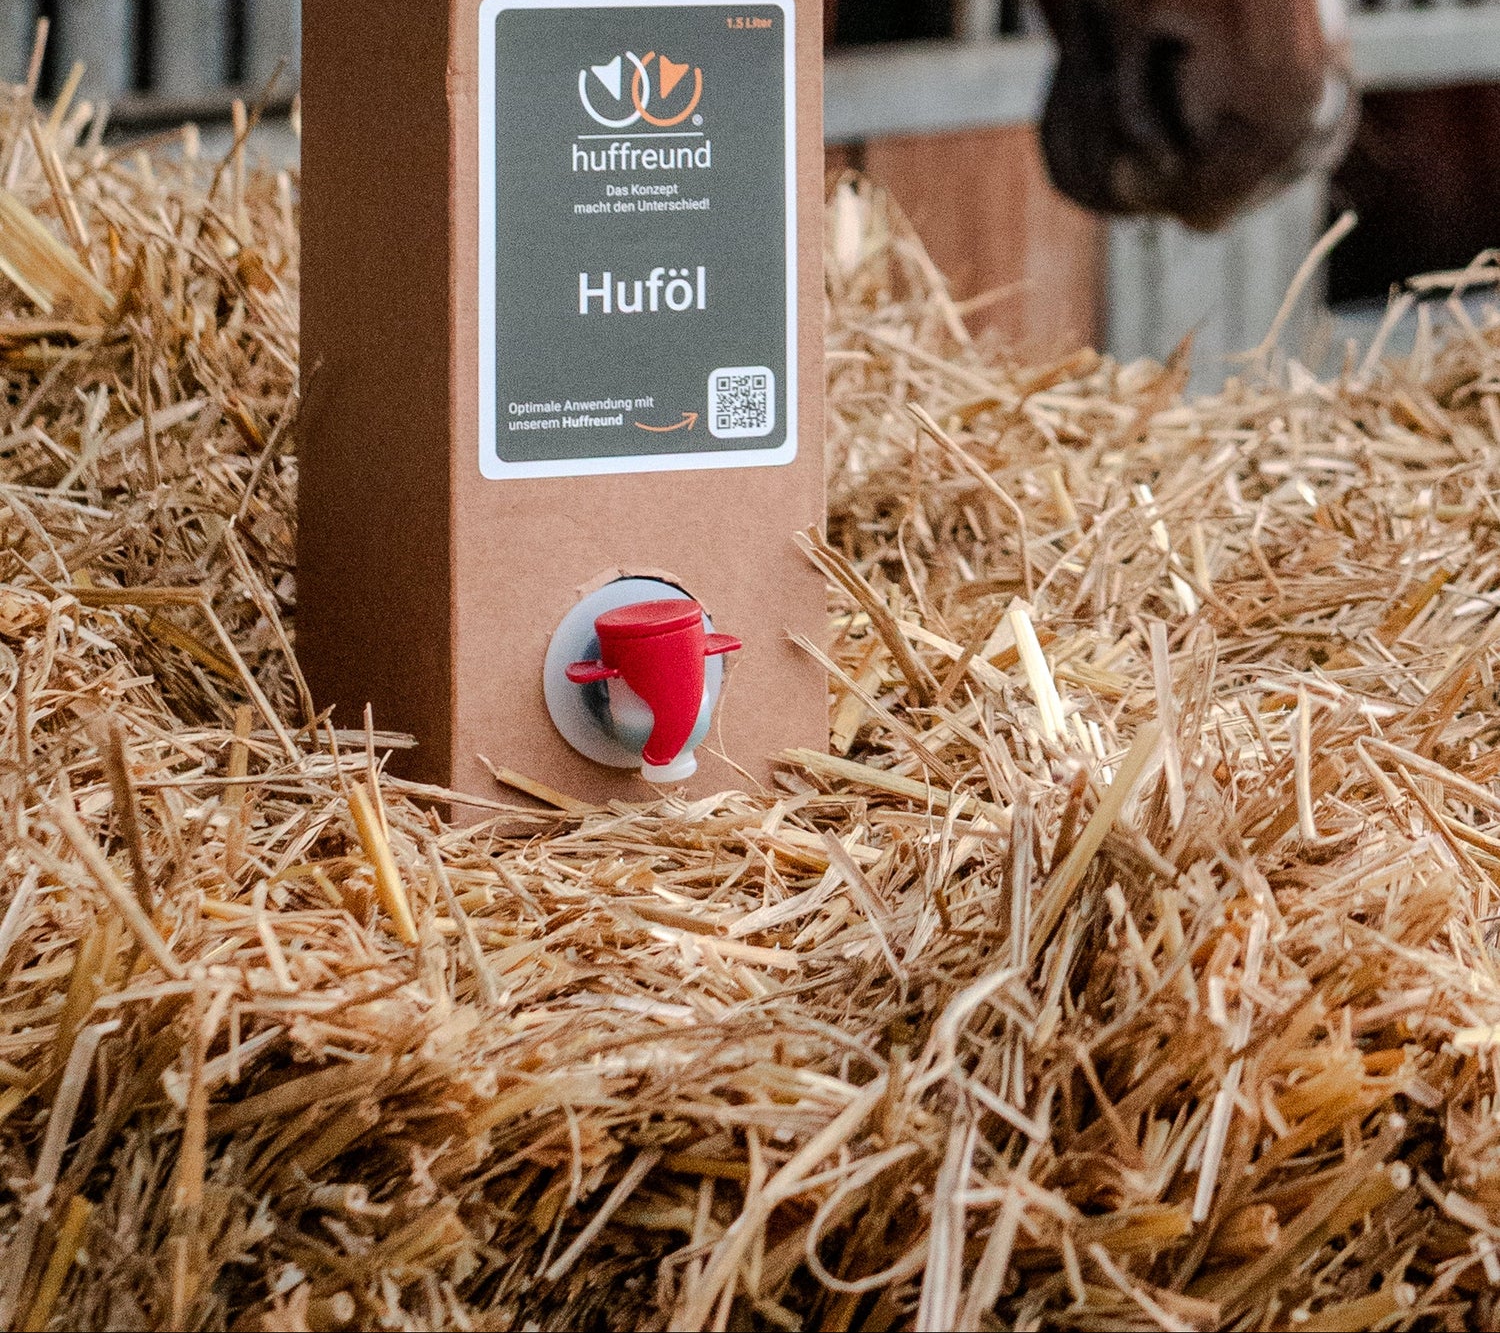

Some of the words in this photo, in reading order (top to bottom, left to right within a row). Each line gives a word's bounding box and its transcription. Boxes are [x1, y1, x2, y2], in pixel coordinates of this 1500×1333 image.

[726, 18, 743, 29] 1.5
[745, 17, 772, 29] Liter
[572, 140, 711, 172] huffreund
[606, 184, 629, 197] Das
[631, 183, 678, 198] Konzept
[574, 202, 610, 214] macht
[613, 201, 635, 212] den
[637, 198, 710, 212] Unterschied!
[579, 266, 706, 314] Huföl
[508, 400, 562, 416] Optimale
[564, 397, 632, 413] Anwendung
[634, 396, 654, 409] mit
[508, 419, 560, 431] unserem
[562, 414, 623, 428] Huffreund
